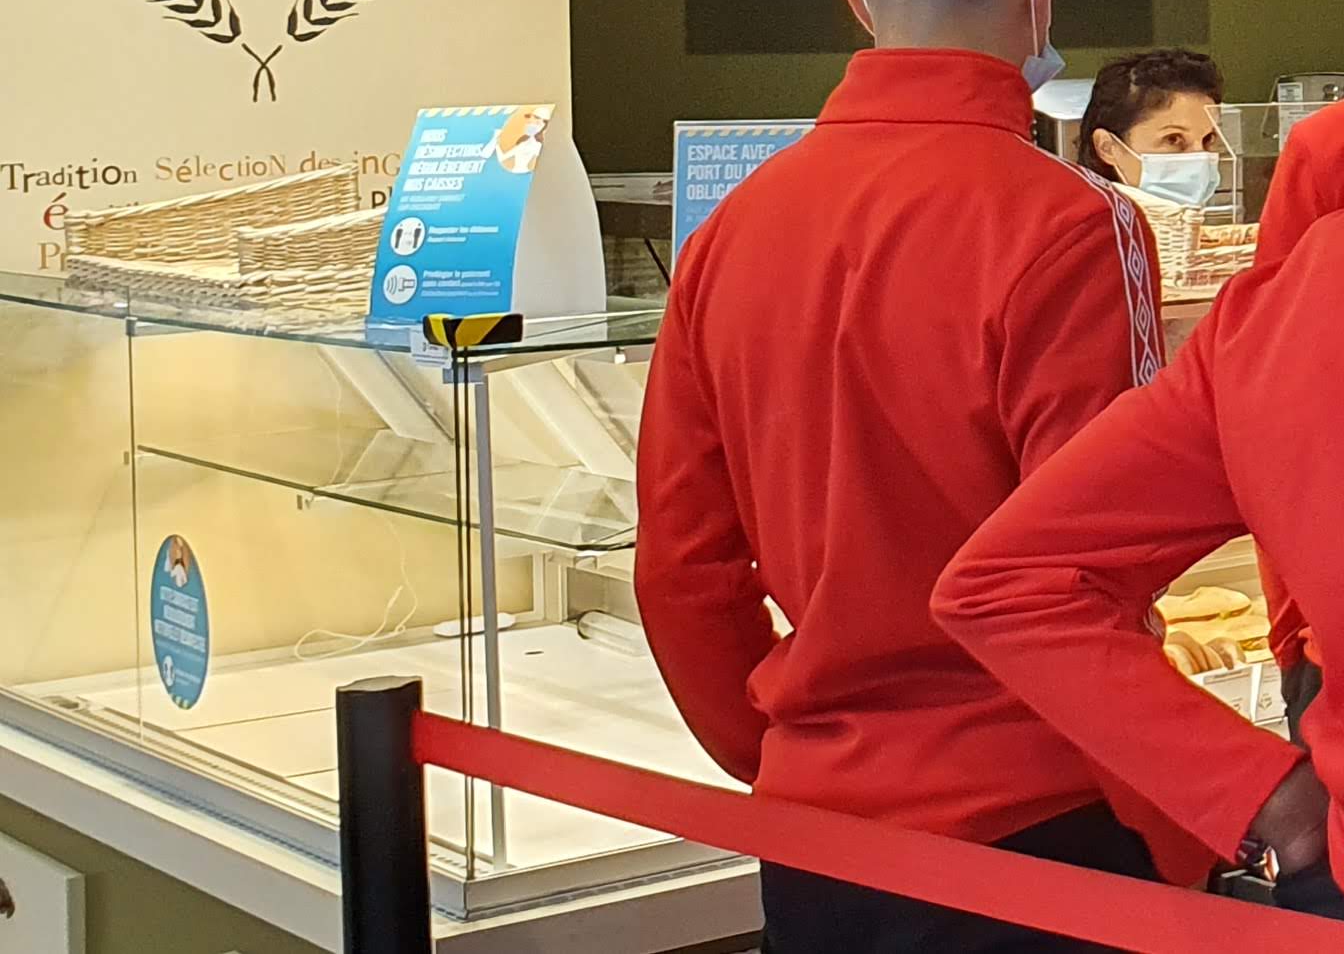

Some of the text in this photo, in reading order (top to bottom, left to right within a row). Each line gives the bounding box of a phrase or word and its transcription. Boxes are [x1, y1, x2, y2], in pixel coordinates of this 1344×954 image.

[687, 144, 737, 161] ESPACE
[0, 157, 138, 193] Tradition
[687, 164, 721, 180] PORT
[724, 163, 743, 179] DU
